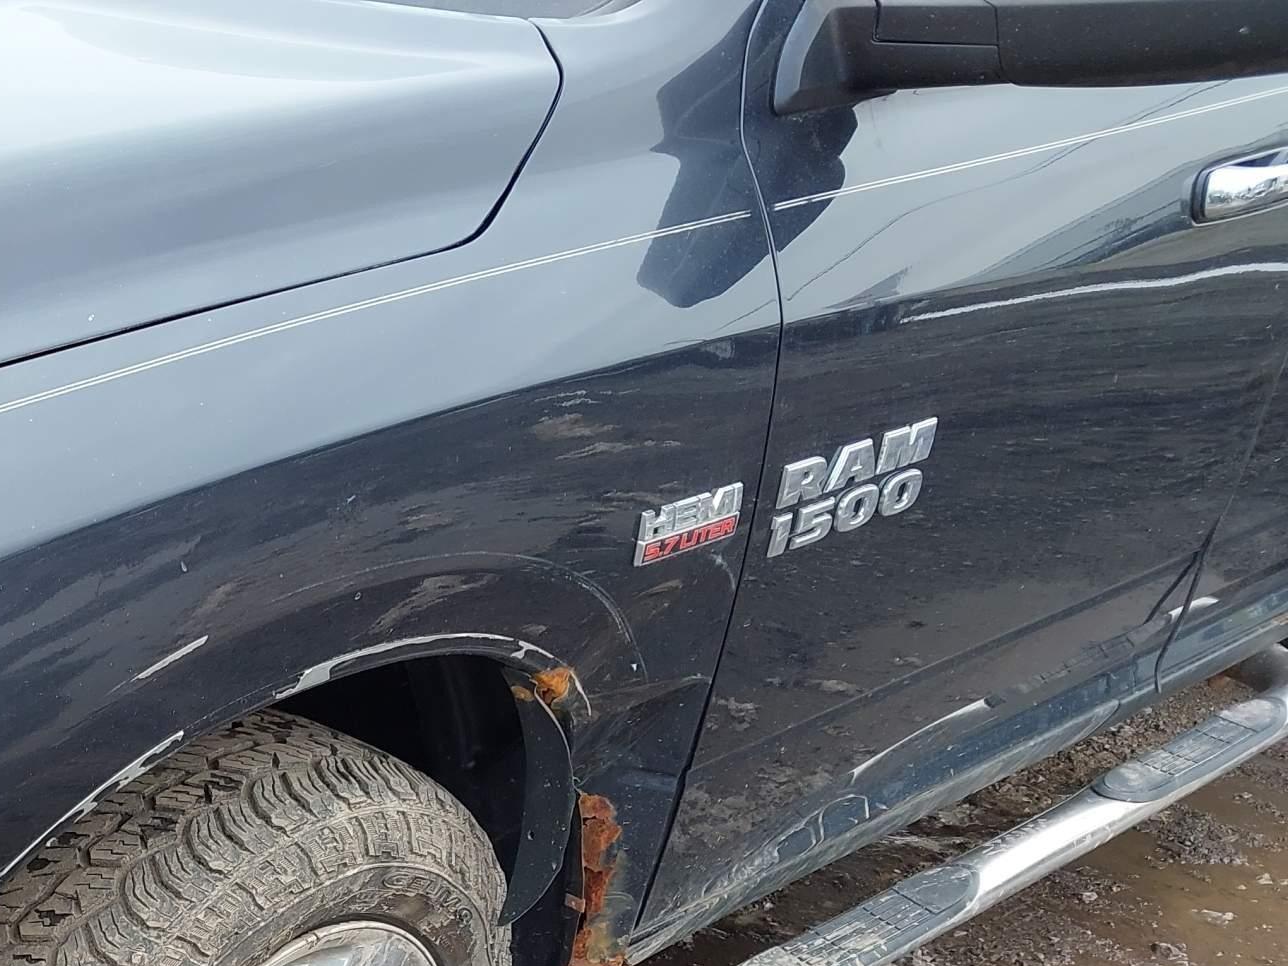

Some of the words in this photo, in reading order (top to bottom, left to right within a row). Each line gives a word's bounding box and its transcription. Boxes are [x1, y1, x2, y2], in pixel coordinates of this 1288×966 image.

[775, 417, 939, 509] RAM
[638, 482, 744, 542] HEMI
[767, 468, 924, 558] 1500
